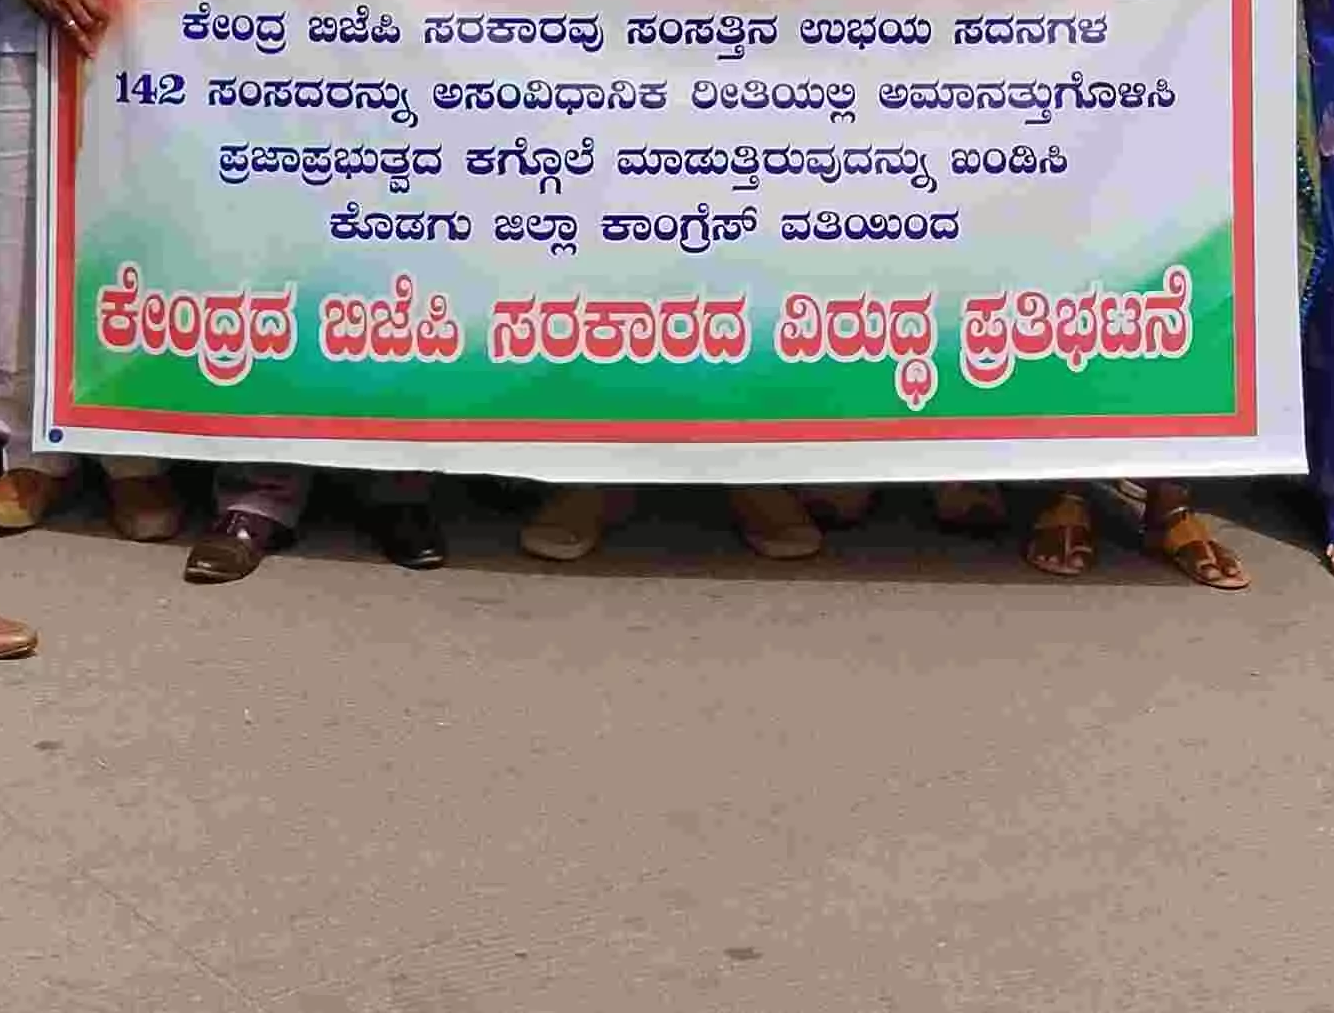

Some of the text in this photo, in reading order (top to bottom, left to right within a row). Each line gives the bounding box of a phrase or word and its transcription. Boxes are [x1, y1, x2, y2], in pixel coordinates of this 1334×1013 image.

[182, 2, 1108, 60] ಕೇಂದ್ರ ಬಿಜೆಪಿ ಸರಕಾರವು ಸಂಸತ್ತಿನ ಉಭಯ ಸದನಗಳ
[116, 71, 1176, 127] 142 ಸಂಸದರನ್ನು ಅಸಂವಿಧಾನಿಕ ರೀತಿಯಲ್ಲಿ ಅಮಾನತ್ತುಗೊಳಿಸಿ
[219, 136, 1069, 194] ಪ್ರಜಾಪ್ರಭುತ್ವದ ಕಗ್ಗೊಲೆ ಮಾಡುತ್ತಿರುವುದನ್ನು ಖಂಡಿಸಿ
[329, 201, 960, 256] ಕೊಡಗು ಜಿಲ್ಲಾ ಕಾಂಗ್ರೆಸ್ ವತಿಯಿಂದ
[99, 265, 1191, 408] ಕೇಂದ್ರದ ಬಿಜೆಪಿ ಸರಕಾರದ ವಿರುದ್ಧ ಪ್ರತಿಭಟನೆ
